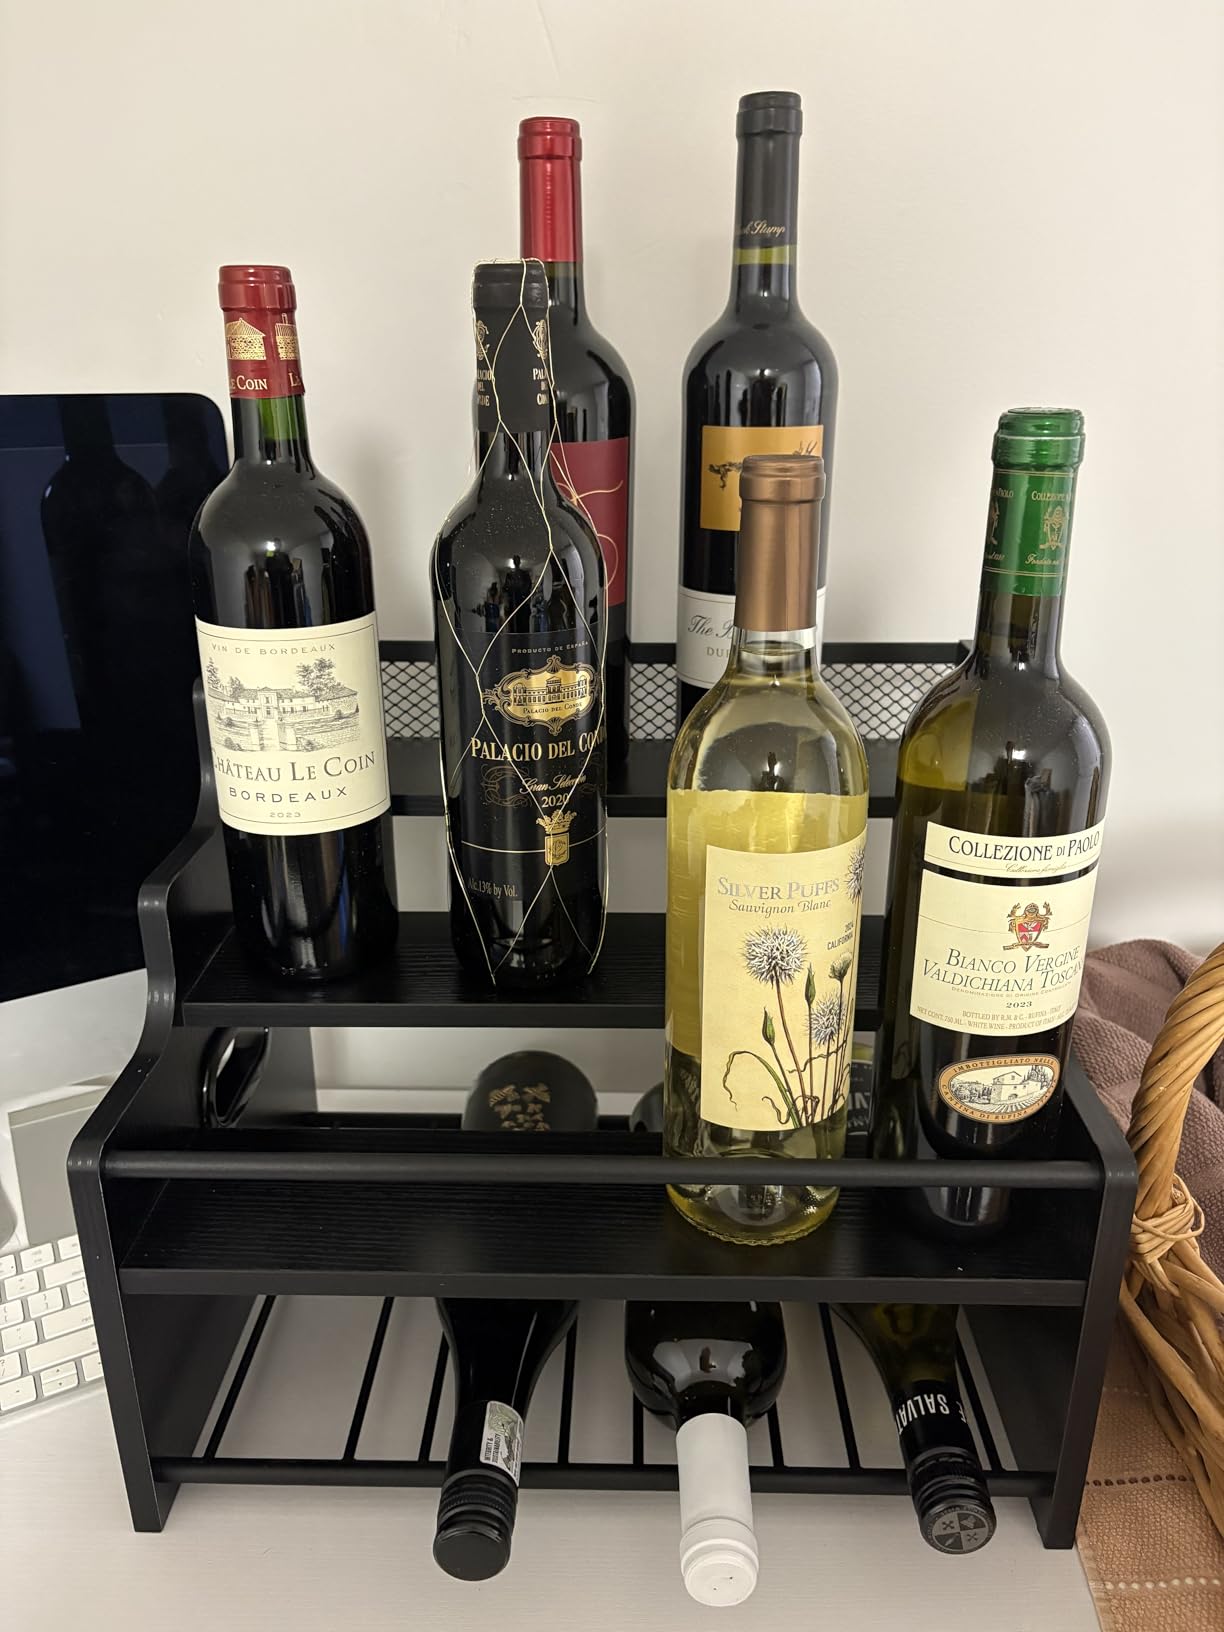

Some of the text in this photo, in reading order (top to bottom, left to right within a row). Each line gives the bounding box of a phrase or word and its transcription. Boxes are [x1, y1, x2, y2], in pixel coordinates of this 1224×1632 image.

[237, 375, 268, 390] COIN
[687, 614, 713, 635] The
[211, 643, 336, 656] VIN DE BORDEAUX
[470, 737, 542, 762] PALACIO
[547, 740, 575, 760] DEL
[214, 751, 376, 782] HÂTEAU LE COIN
[228, 786, 348, 803] BORDEAUX
[948, 835, 1053, 862] COLLEZIONE
[1067, 831, 1100, 857] PAOLO
[493, 883, 502, 899] by
[503, 884, 518, 897] Vol.
[717, 877, 840, 900] SILVER PUFFS
[728, 899, 832, 919] Sauvignon Blanc
[945, 946, 1080, 974] BIANCO VERGINE
[923, 958, 1033, 992] VALDICHIANA
[962, 1010, 990, 1021] BOTTLED
[991, 1013, 1000, 1021] BY
[967, 1021, 988, 1029] WHITE
[988, 1022, 1005, 1030] WINE
[1008, 1020, 1035, 1030] PRODUCT
[953, 1057, 1031, 1073] IMBOTTIGLIATO
[941, 1084, 975, 1116] CANTINA
